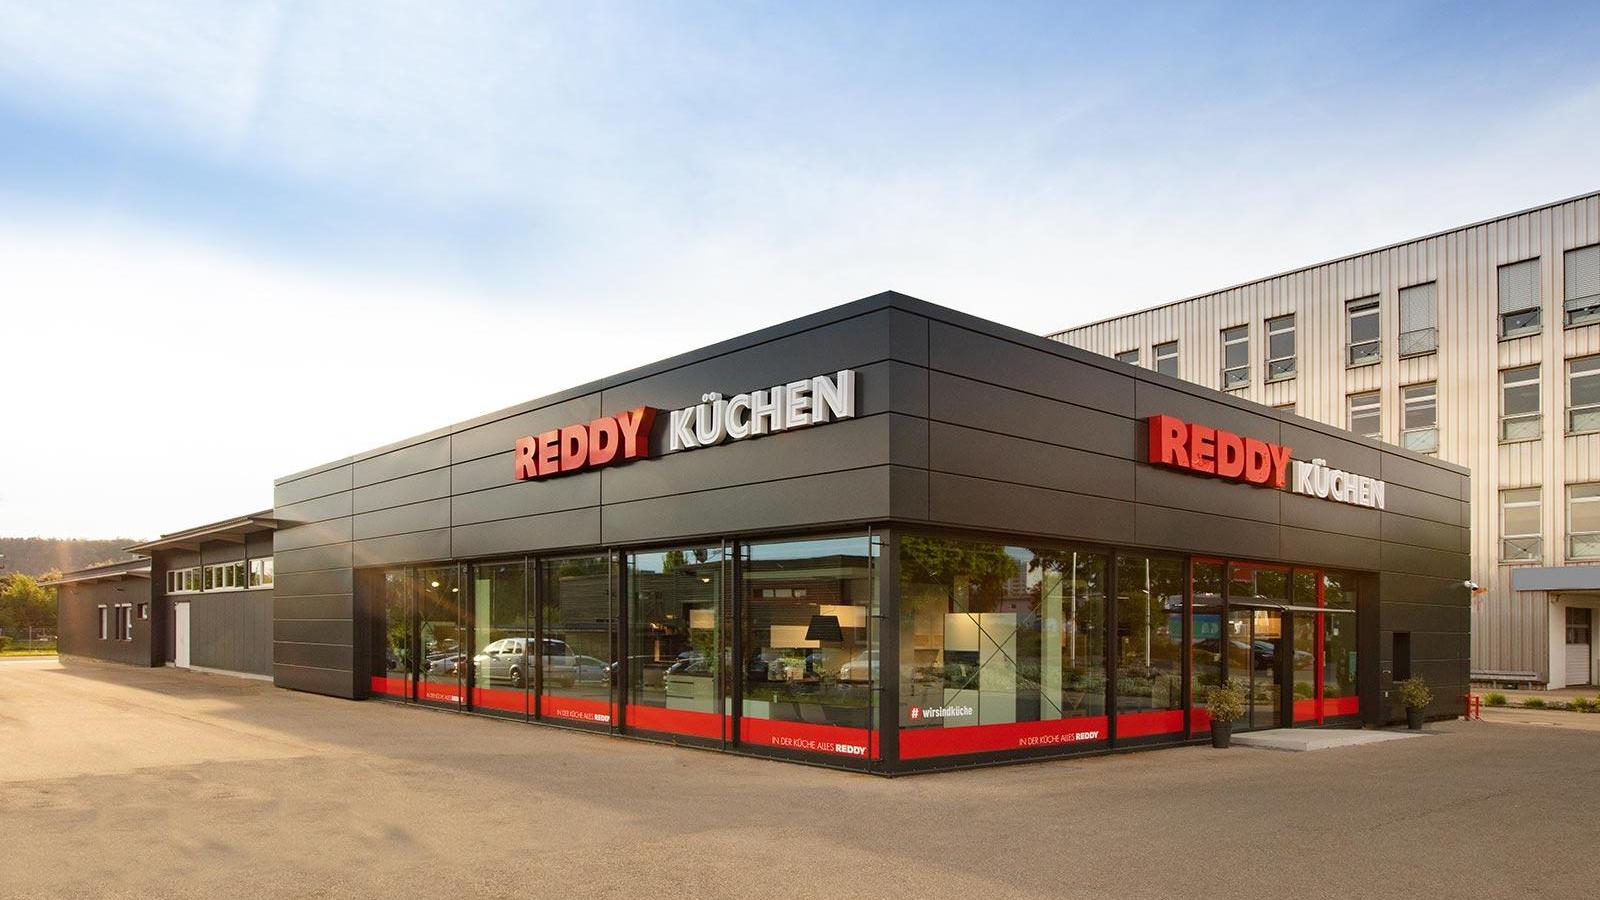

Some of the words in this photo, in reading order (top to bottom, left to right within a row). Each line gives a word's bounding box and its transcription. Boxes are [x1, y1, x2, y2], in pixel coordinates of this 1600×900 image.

[515, 406, 657, 480] REDDY
[670, 369, 855, 450] KÜCHEN
[1148, 415, 1294, 488] REDDY
[1292, 458, 1385, 509] KÜCHEN
[772, 736, 779, 744] IN
[781, 737, 792, 746] DER
[835, 744, 866, 755] REDDY
[1075, 731, 1099, 741] REDDY
